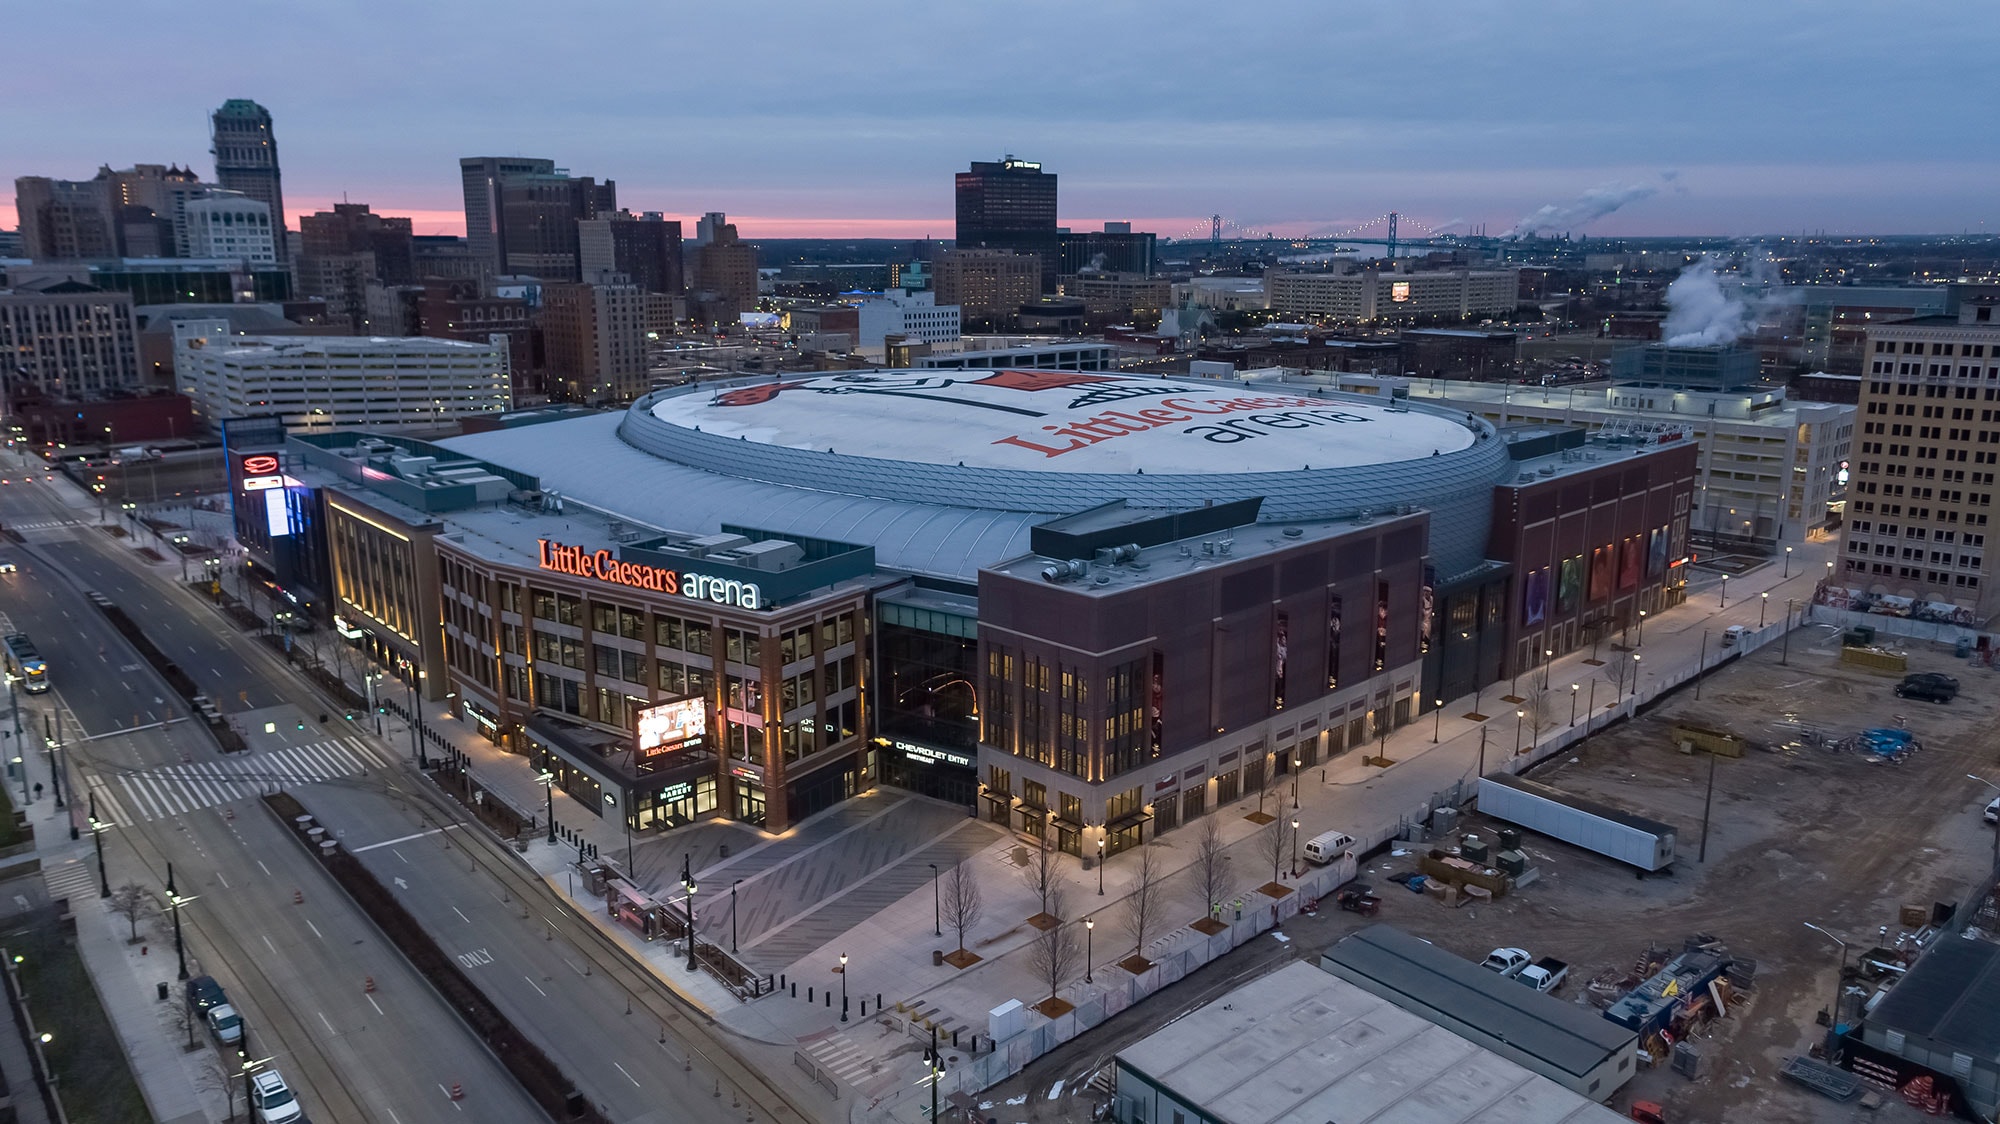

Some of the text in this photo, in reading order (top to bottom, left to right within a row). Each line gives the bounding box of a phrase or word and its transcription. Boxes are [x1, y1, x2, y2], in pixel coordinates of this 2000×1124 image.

[991, 397, 1369, 458] Little Caesars
[1183, 410, 1375, 443] arena
[537, 538, 761, 610] Little Caesars arena
[895, 741, 969, 766] CHEVROLET ENTRY
[660, 785, 692, 800] MARKET
[457, 947, 494, 968] ONLY
